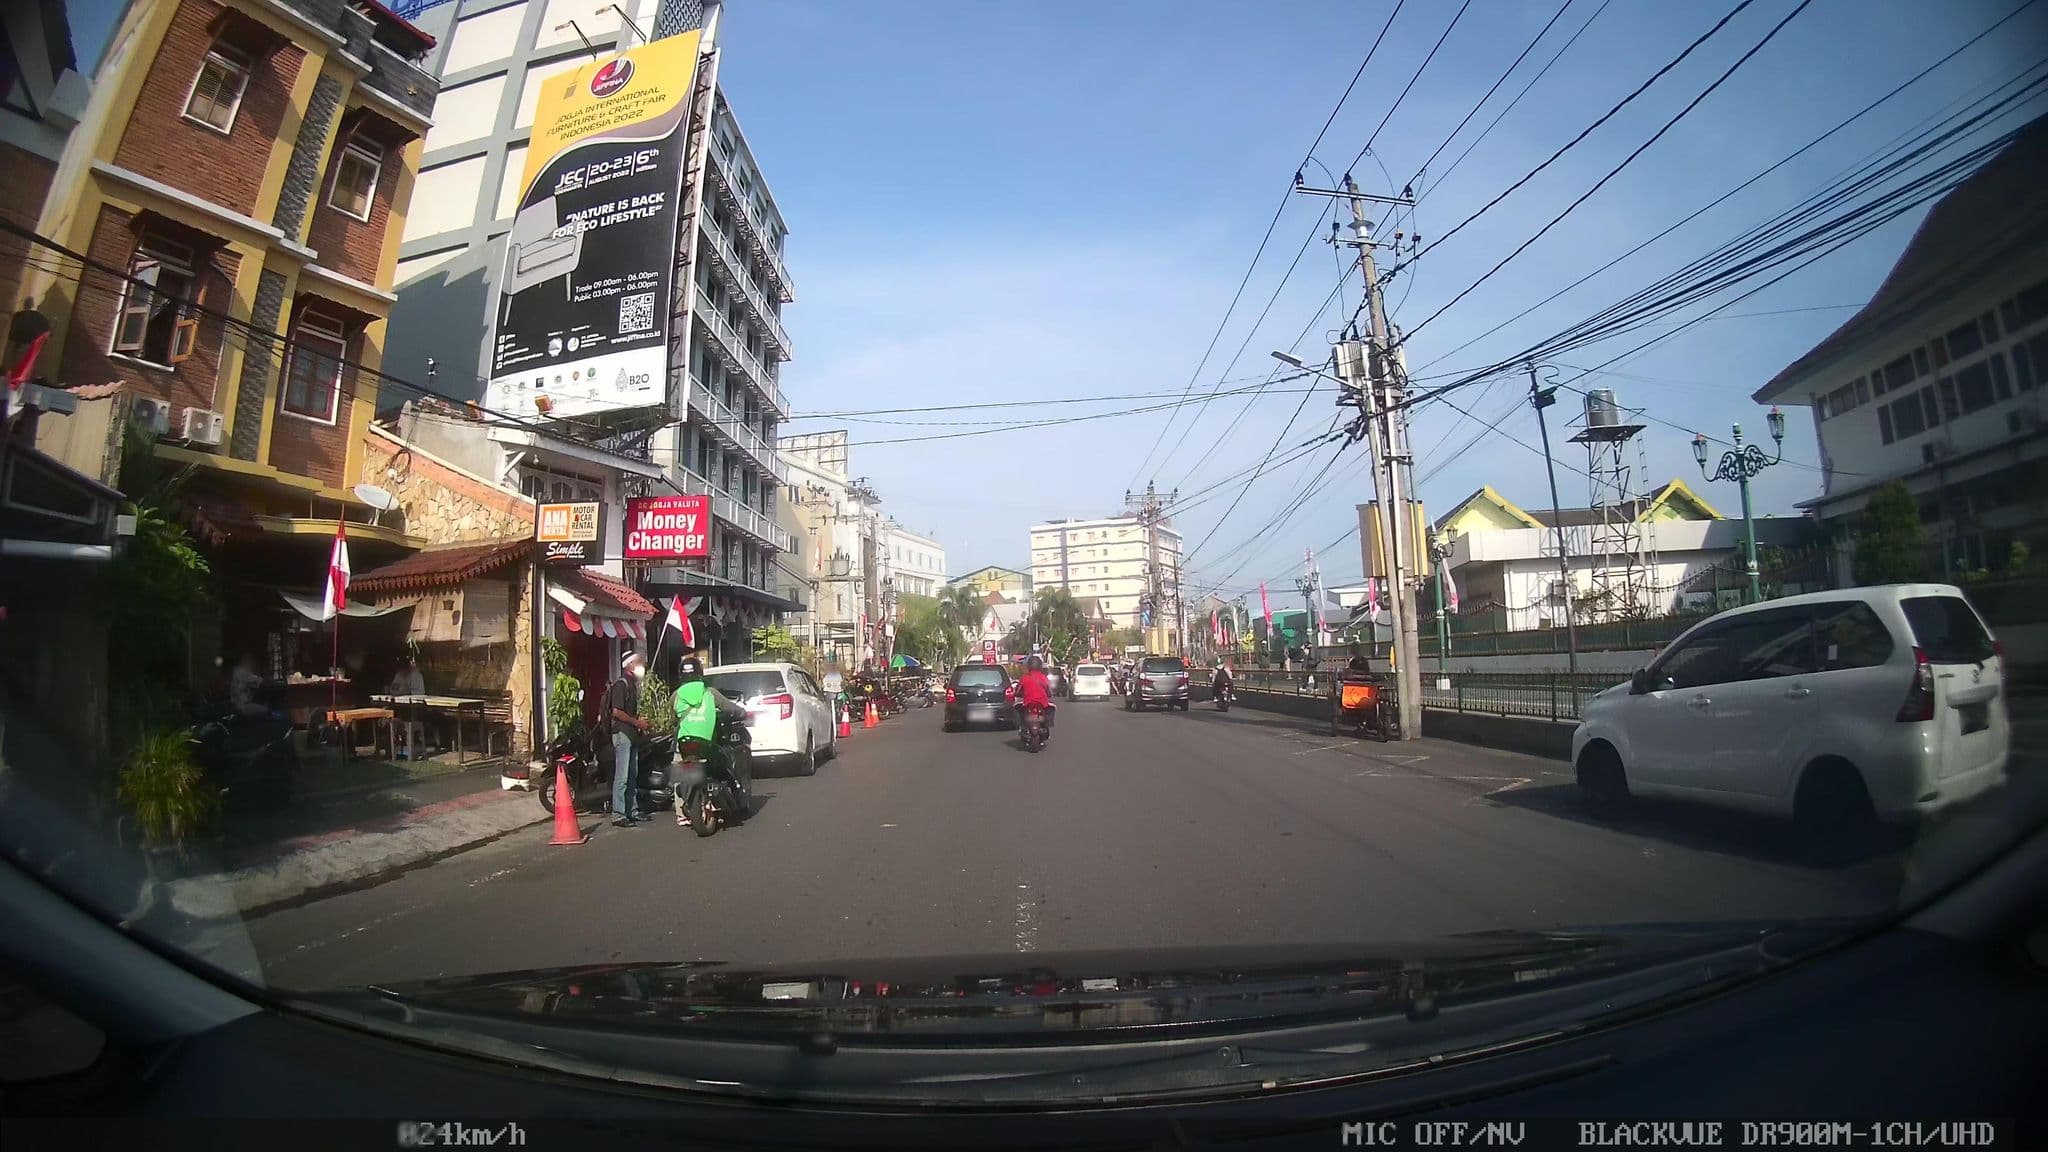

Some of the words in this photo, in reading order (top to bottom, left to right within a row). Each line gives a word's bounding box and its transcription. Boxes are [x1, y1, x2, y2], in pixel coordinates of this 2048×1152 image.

[546, 113, 598, 136] FURNITURE
[608, 101, 641, 116] CRAFT
[643, 94, 666, 106] FAIR
[555, 110, 584, 125] JOGJA
[585, 87, 660, 113] INTERNATIONAL
[560, 120, 611, 140] INDONESIA
[614, 110, 644, 123] 2022
[555, 168, 585, 188] JEC
[590, 155, 633, 176] 20-23
[636, 149, 659, 165] 6th
[588, 174, 612, 185] AUGUST
[612, 170, 630, 179] 2022
[566, 203, 615, 223] "NATURE
[618, 199, 629, 210] IS
[631, 192, 665, 207] BACK
[552, 226, 573, 240] FOR
[576, 220, 597, 233] ECO
[600, 205, 663, 227] LIFESTYLE"
[574, 293, 592, 303] Public
[627, 281, 658, 291] 06.00pm
[576, 284, 592, 293] Trade
[593, 278, 622, 289] 09.00am
[628, 271, 659, 281] 06.00pm
[573, 506, 595, 514] MOTOR
[649, 501, 671, 510] JOGJA
[673, 500, 700, 508] VALUTA
[572, 522, 594, 530] RENTAL
[581, 514, 592, 522] CAR
[637, 511, 697, 533] Money
[546, 542, 584, 558] Simple
[628, 531, 705, 554] Changer
